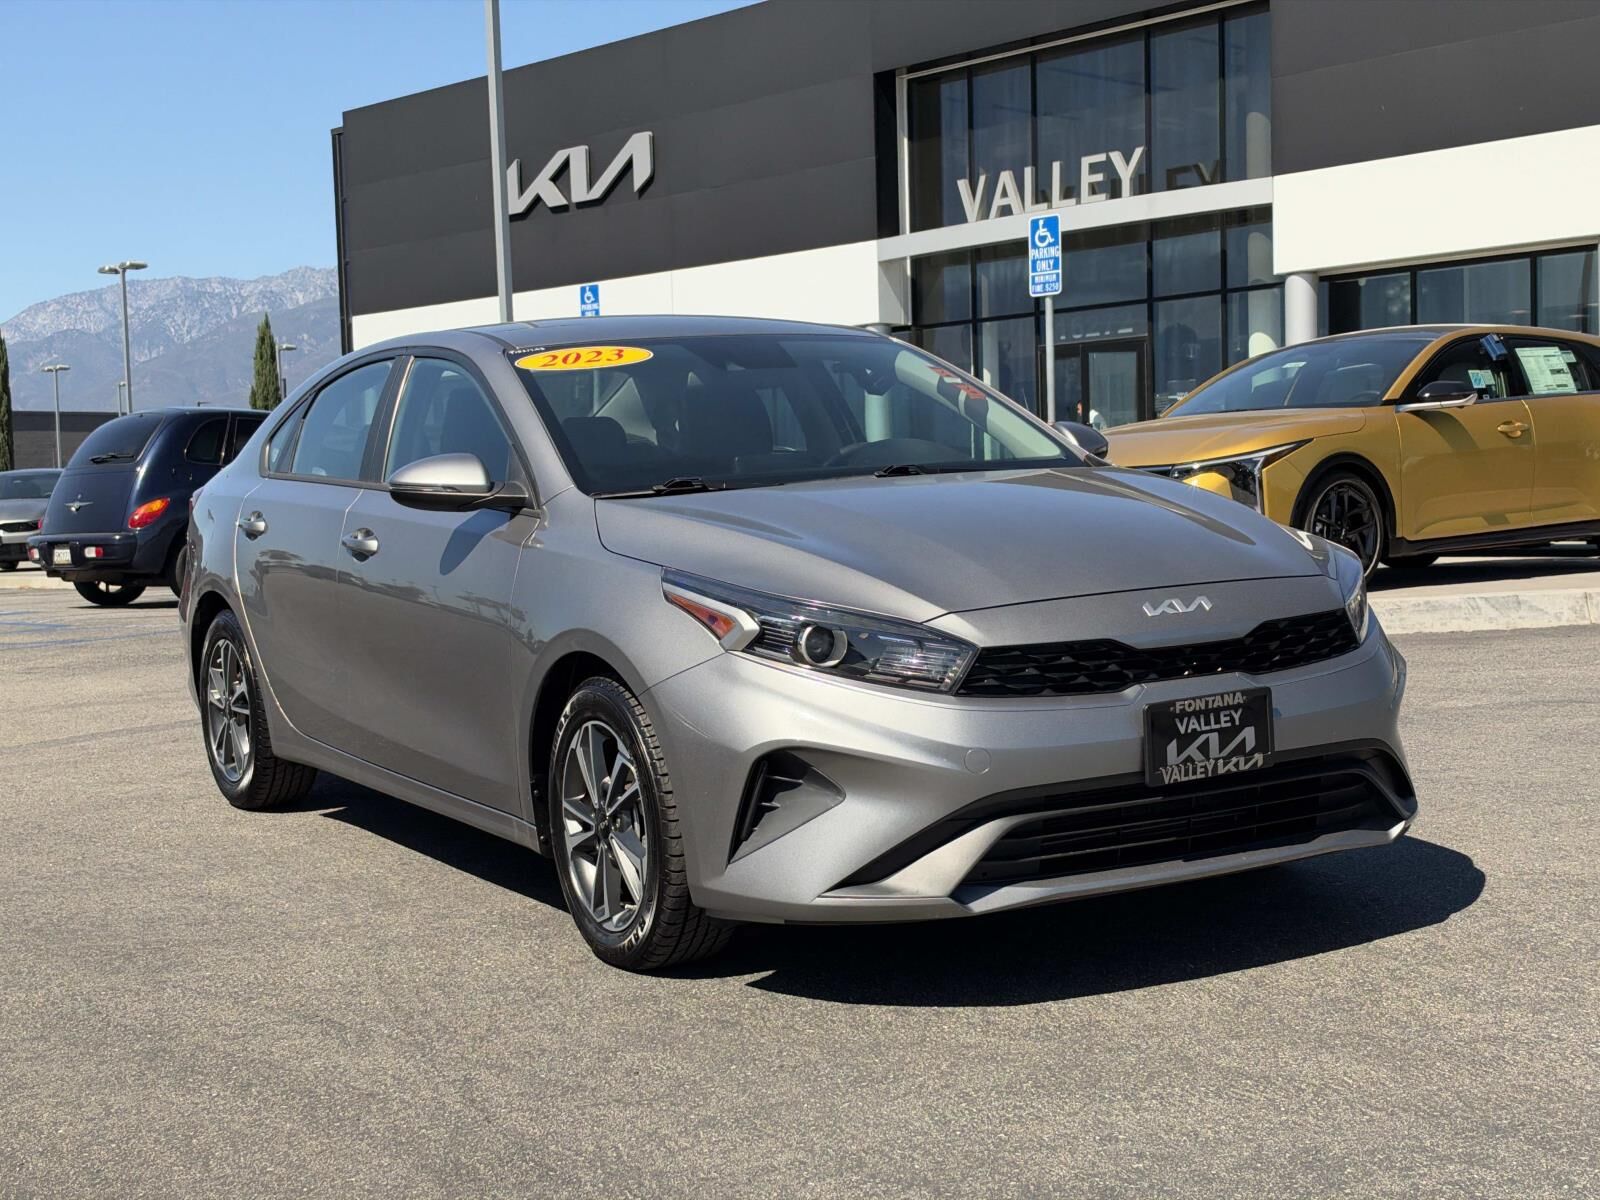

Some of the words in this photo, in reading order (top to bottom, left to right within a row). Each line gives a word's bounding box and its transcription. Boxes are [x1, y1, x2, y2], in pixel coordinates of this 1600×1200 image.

[506, 131, 654, 216] KIA
[957, 146, 1145, 223] VALLEY
[1031, 246, 1060, 260] PARKING
[1036, 259, 1054, 272] ONLY
[539, 349, 625, 367] 2023
[1142, 595, 1213, 617] KIA
[1175, 692, 1244, 714] FONTANA
[1175, 708, 1243, 735] VALLEY
[1166, 726, 1256, 766] KIA
[1160, 758, 1216, 785] VALLEY
[1217, 752, 1264, 775] KIA
